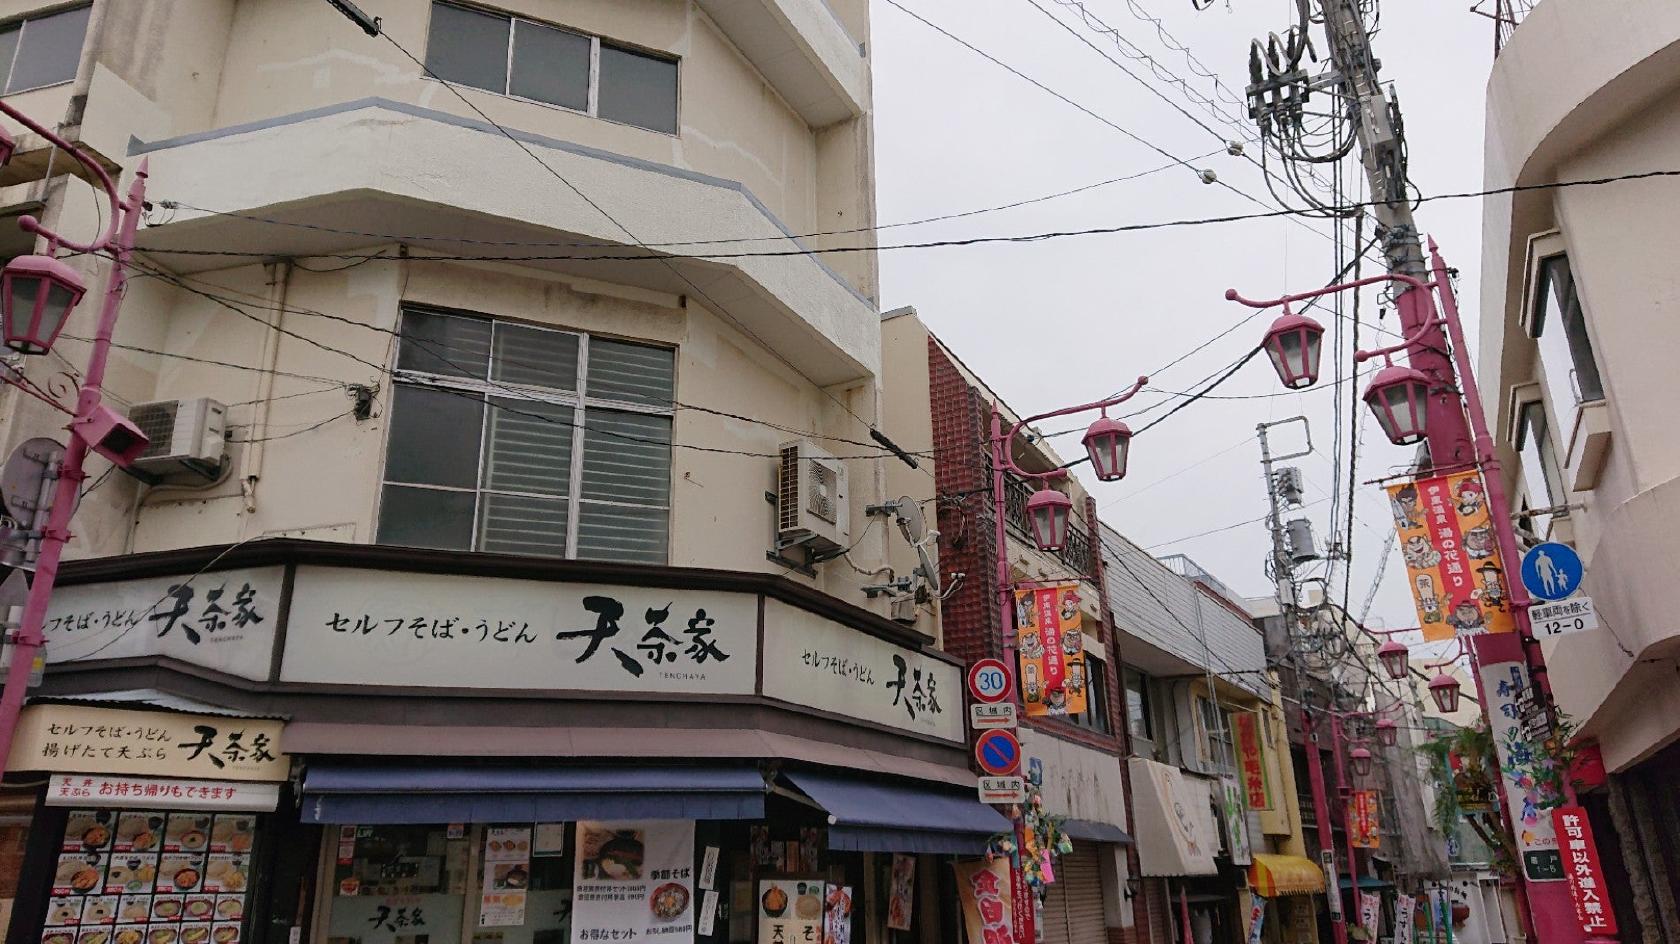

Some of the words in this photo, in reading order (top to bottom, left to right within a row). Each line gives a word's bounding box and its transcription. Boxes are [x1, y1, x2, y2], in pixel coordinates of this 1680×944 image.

[1438, 528, 1464, 587] 湯の花通り
[42, 610, 140, 632] フそば・うどん
[149, 583, 264, 645] 天茶家
[1532, 602, 1590, 620] 軽車両を除く
[325, 612, 538, 644] セルフそば・うどん
[556, 595, 731, 679] 天茶家
[801, 649, 875, 685] セルフそば・うどん
[886, 654, 942, 721] 天茶家
[979, 672, 1003, 691] 30
[975, 706, 1012, 716] 区域内
[48, 723, 172, 742] セルフそば・うどん
[42, 742, 167, 760] 揚げたて天ぷら
[178, 725, 276, 769] 天茶家
[99, 782, 237, 800] お持ち帰りもできます
[983, 780, 1020, 790] 区域内
[1562, 815, 1607, 928] 許可車以外進入禁止
[579, 928, 637, 940] お得なセット
[773, 925, 785, 944] 天
